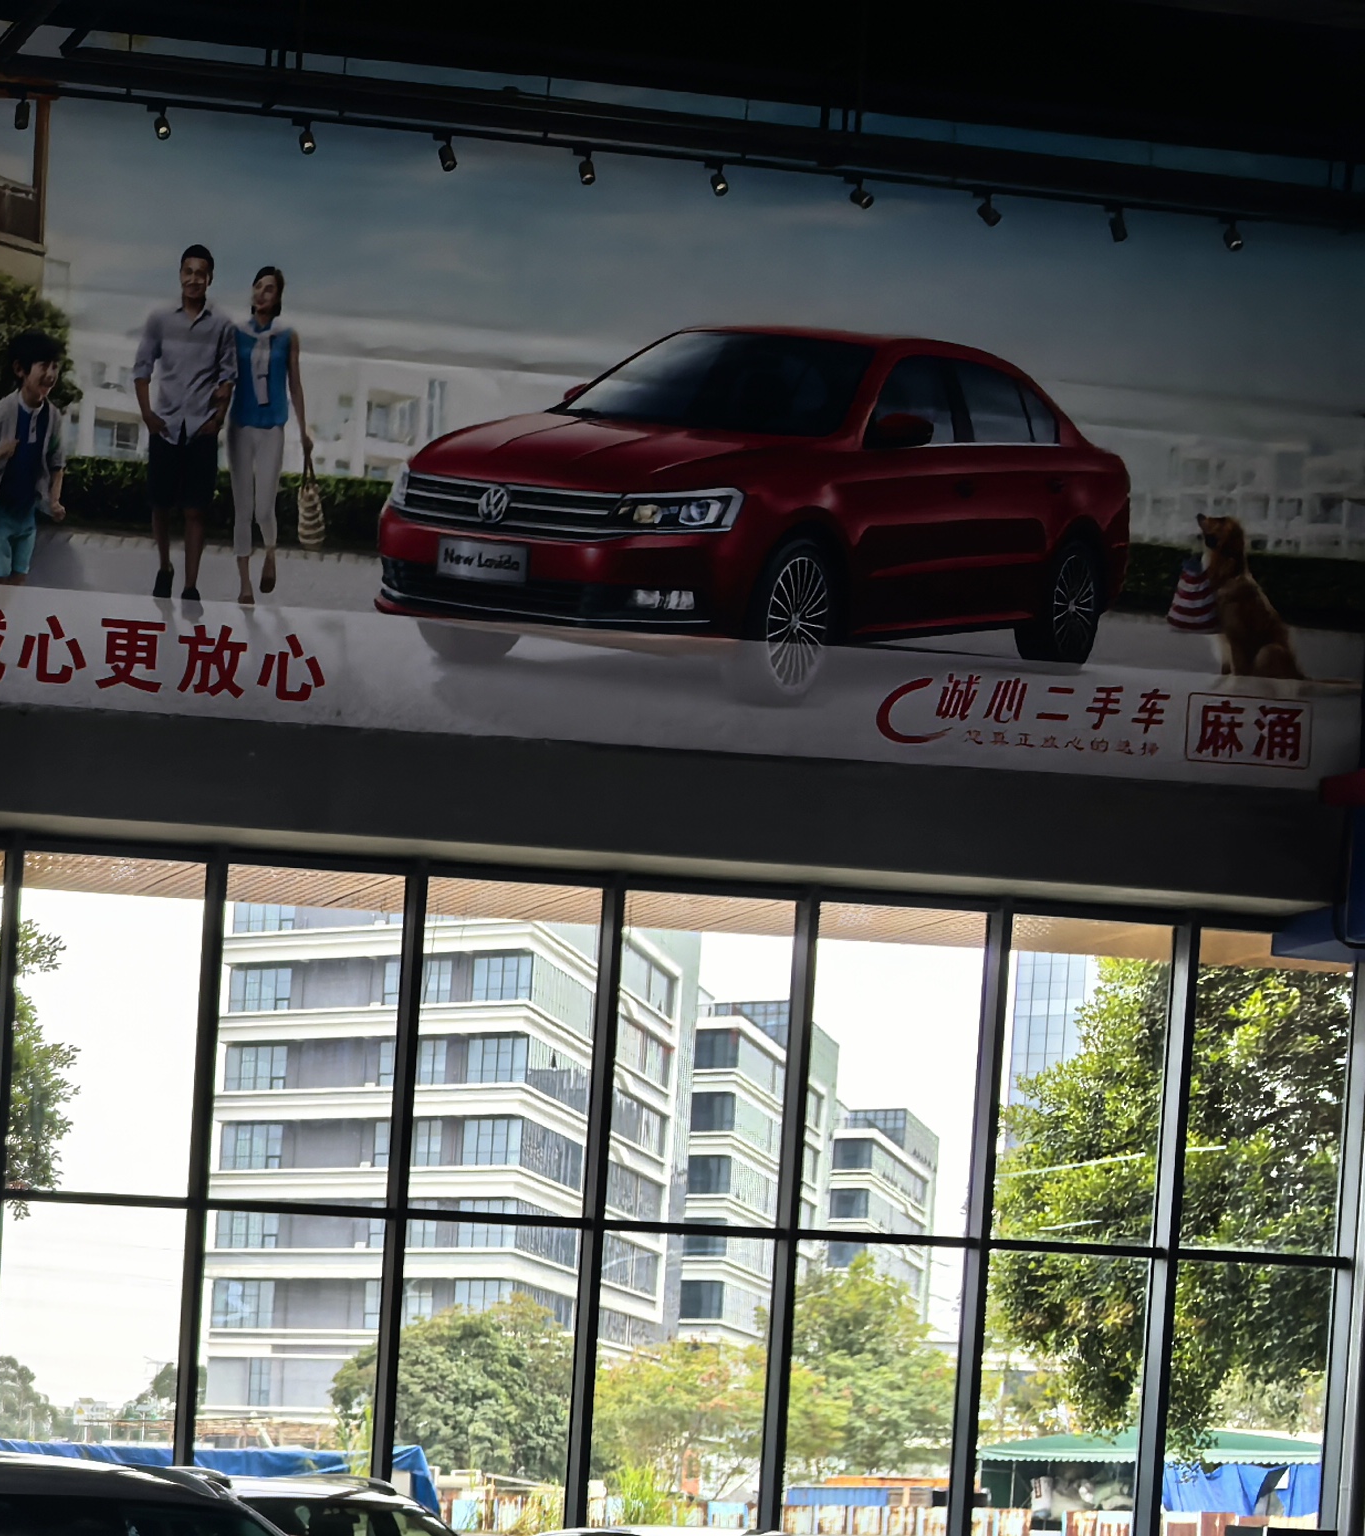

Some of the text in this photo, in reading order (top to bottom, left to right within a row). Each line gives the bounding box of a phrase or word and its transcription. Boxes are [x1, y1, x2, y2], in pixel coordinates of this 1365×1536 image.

[443, 546, 474, 567] New
[935, 673, 1304, 763] 诚心二手车 麻涌
